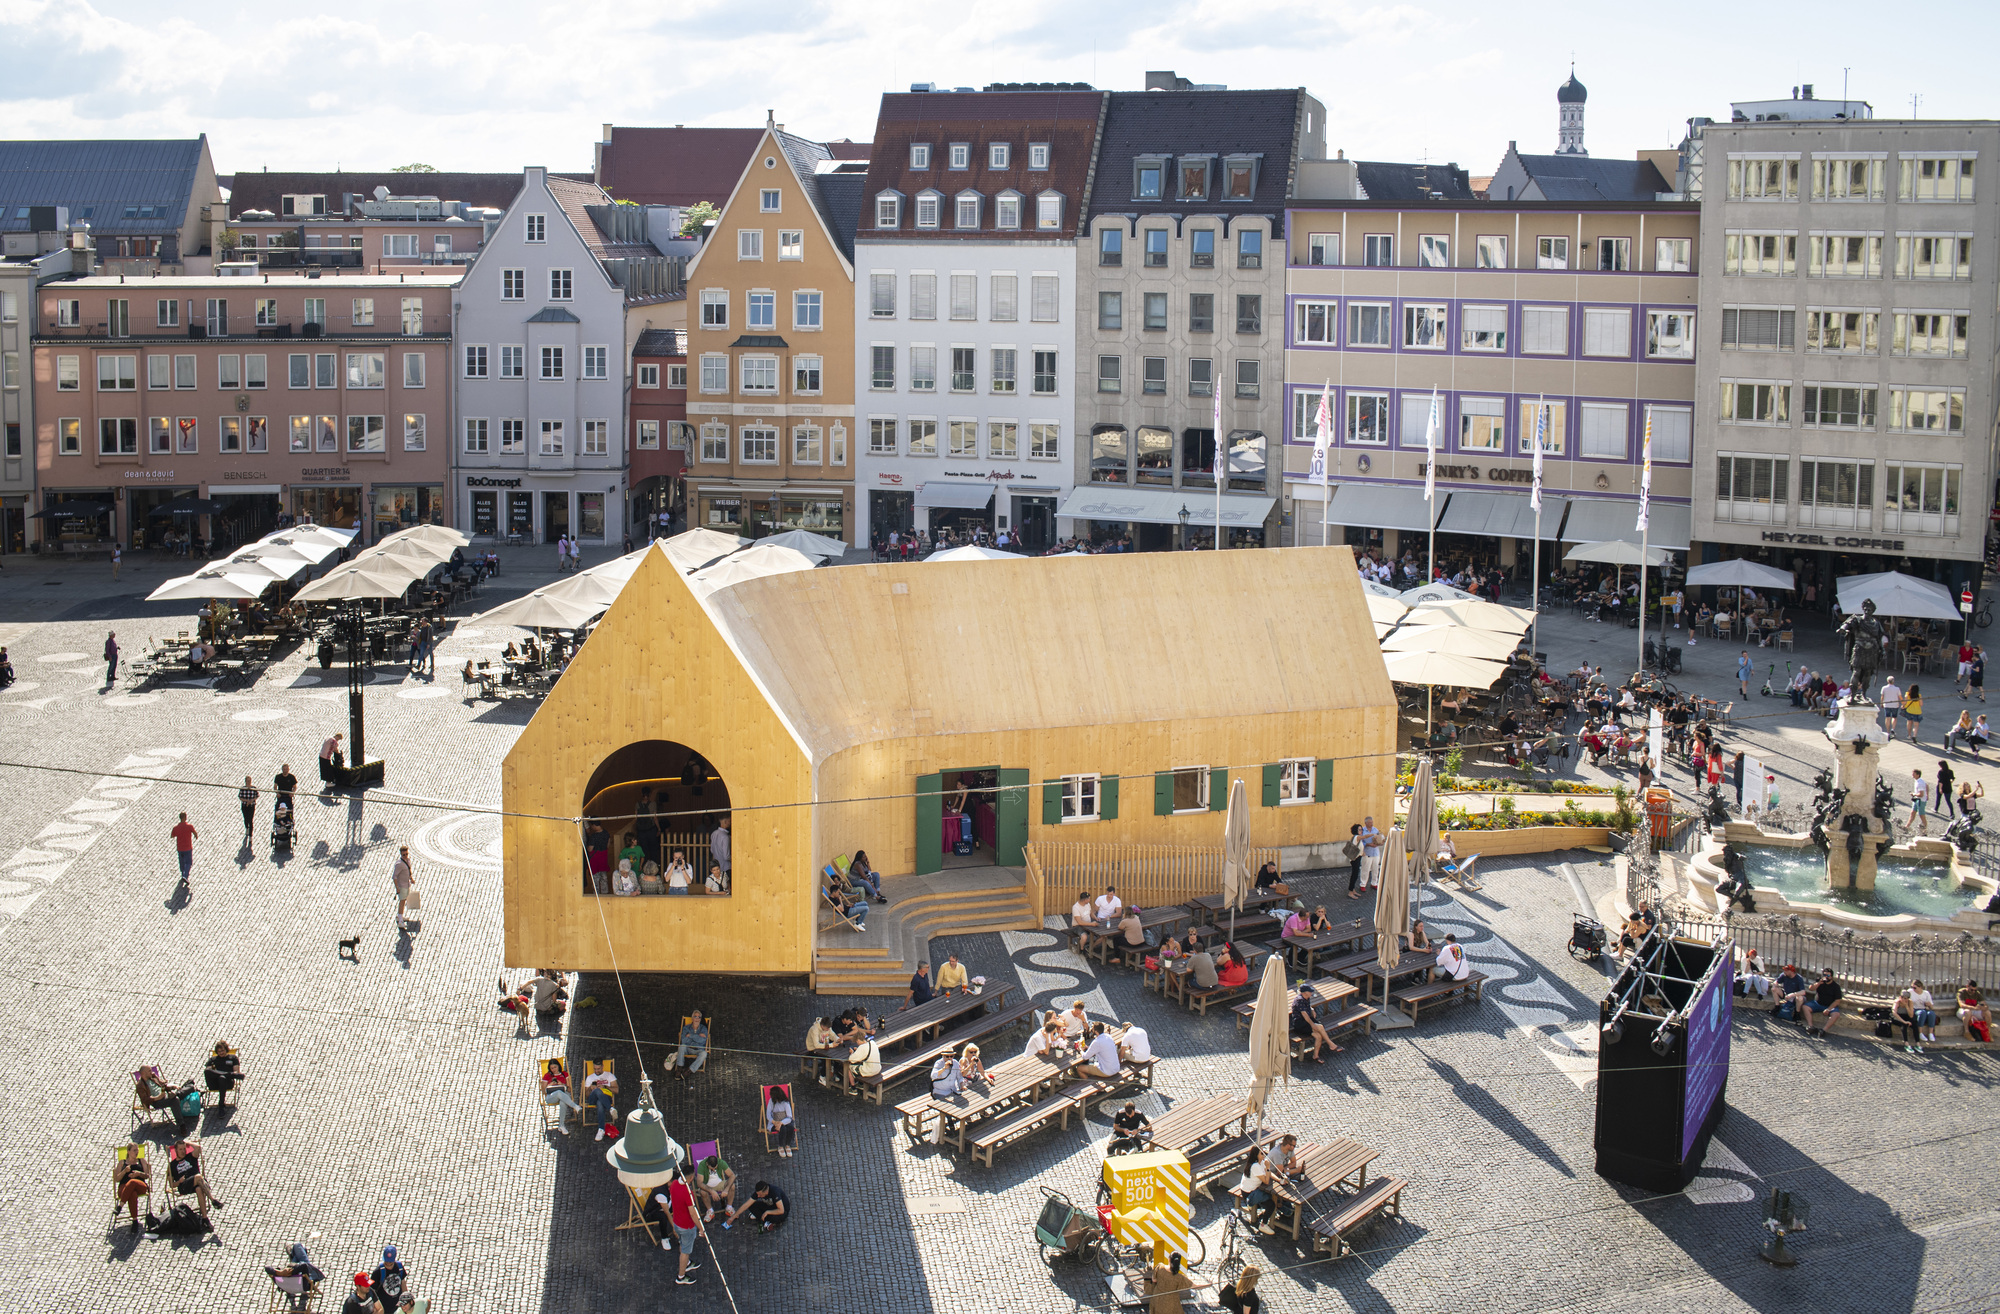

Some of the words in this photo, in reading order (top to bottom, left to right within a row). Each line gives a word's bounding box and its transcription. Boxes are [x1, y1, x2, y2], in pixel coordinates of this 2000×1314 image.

[124, 470, 145, 478] dean
[151, 470, 174, 478] david
[301, 468, 341, 476] QUARTIER
[1488, 468, 1533, 483] COFFE
[467, 477, 522, 489] BoConcept
[1762, 531, 1829, 545] HEYZEL
[1834, 536, 1905, 550] COFFEE
[1126, 1174, 1154, 1188] next
[1125, 1185, 1154, 1203] 500
